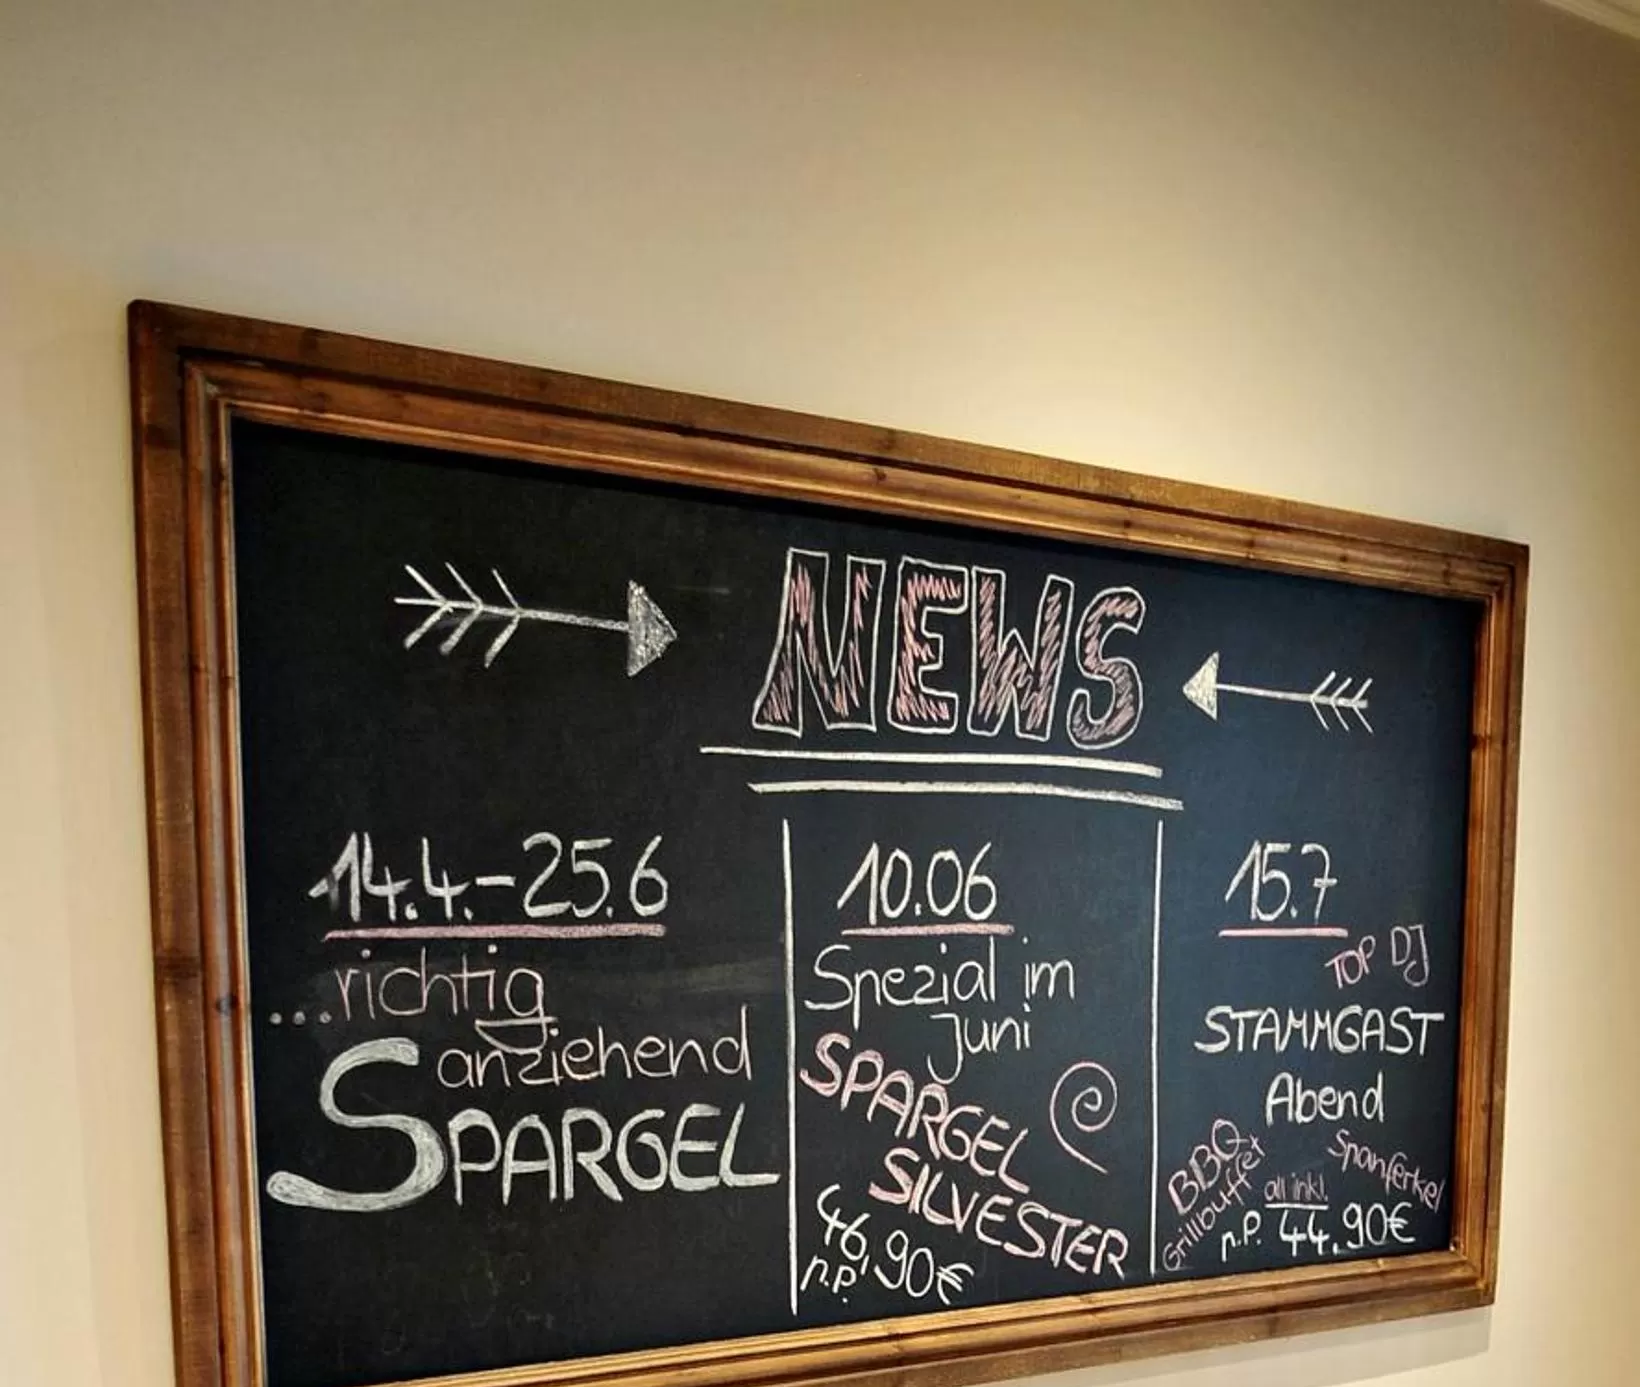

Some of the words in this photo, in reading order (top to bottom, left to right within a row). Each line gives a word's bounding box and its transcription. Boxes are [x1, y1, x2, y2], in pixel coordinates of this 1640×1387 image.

[752, 547, 1146, 751] NEWS
[836, 841, 998, 926] 10.06
[1225, 839, 1339, 927] 15.7
[804, 935, 997, 1033] Spezial
[1023, 936, 1077, 1001] im
[1324, 934, 1376, 990] TOP
[1389, 923, 1432, 988] DJ
[437, 1003, 753, 1089] anziehend
[926, 1003, 1032, 1085] Juni
[1193, 1005, 1446, 1058] STAMMGAST
[266, 1037, 781, 1213] SPARGEL
[799, 1032, 1031, 1195] SPARGEL
[1263, 1071, 1386, 1128] Abend
[1161, 1133, 1266, 1272] Grillbuffet
[1167, 1118, 1249, 1217] BBQ
[1263, 1174, 1286, 1202] all
[1326, 1128, 1446, 1214] Spanferkel
[867, 1147, 1131, 1281] SILVESTER
